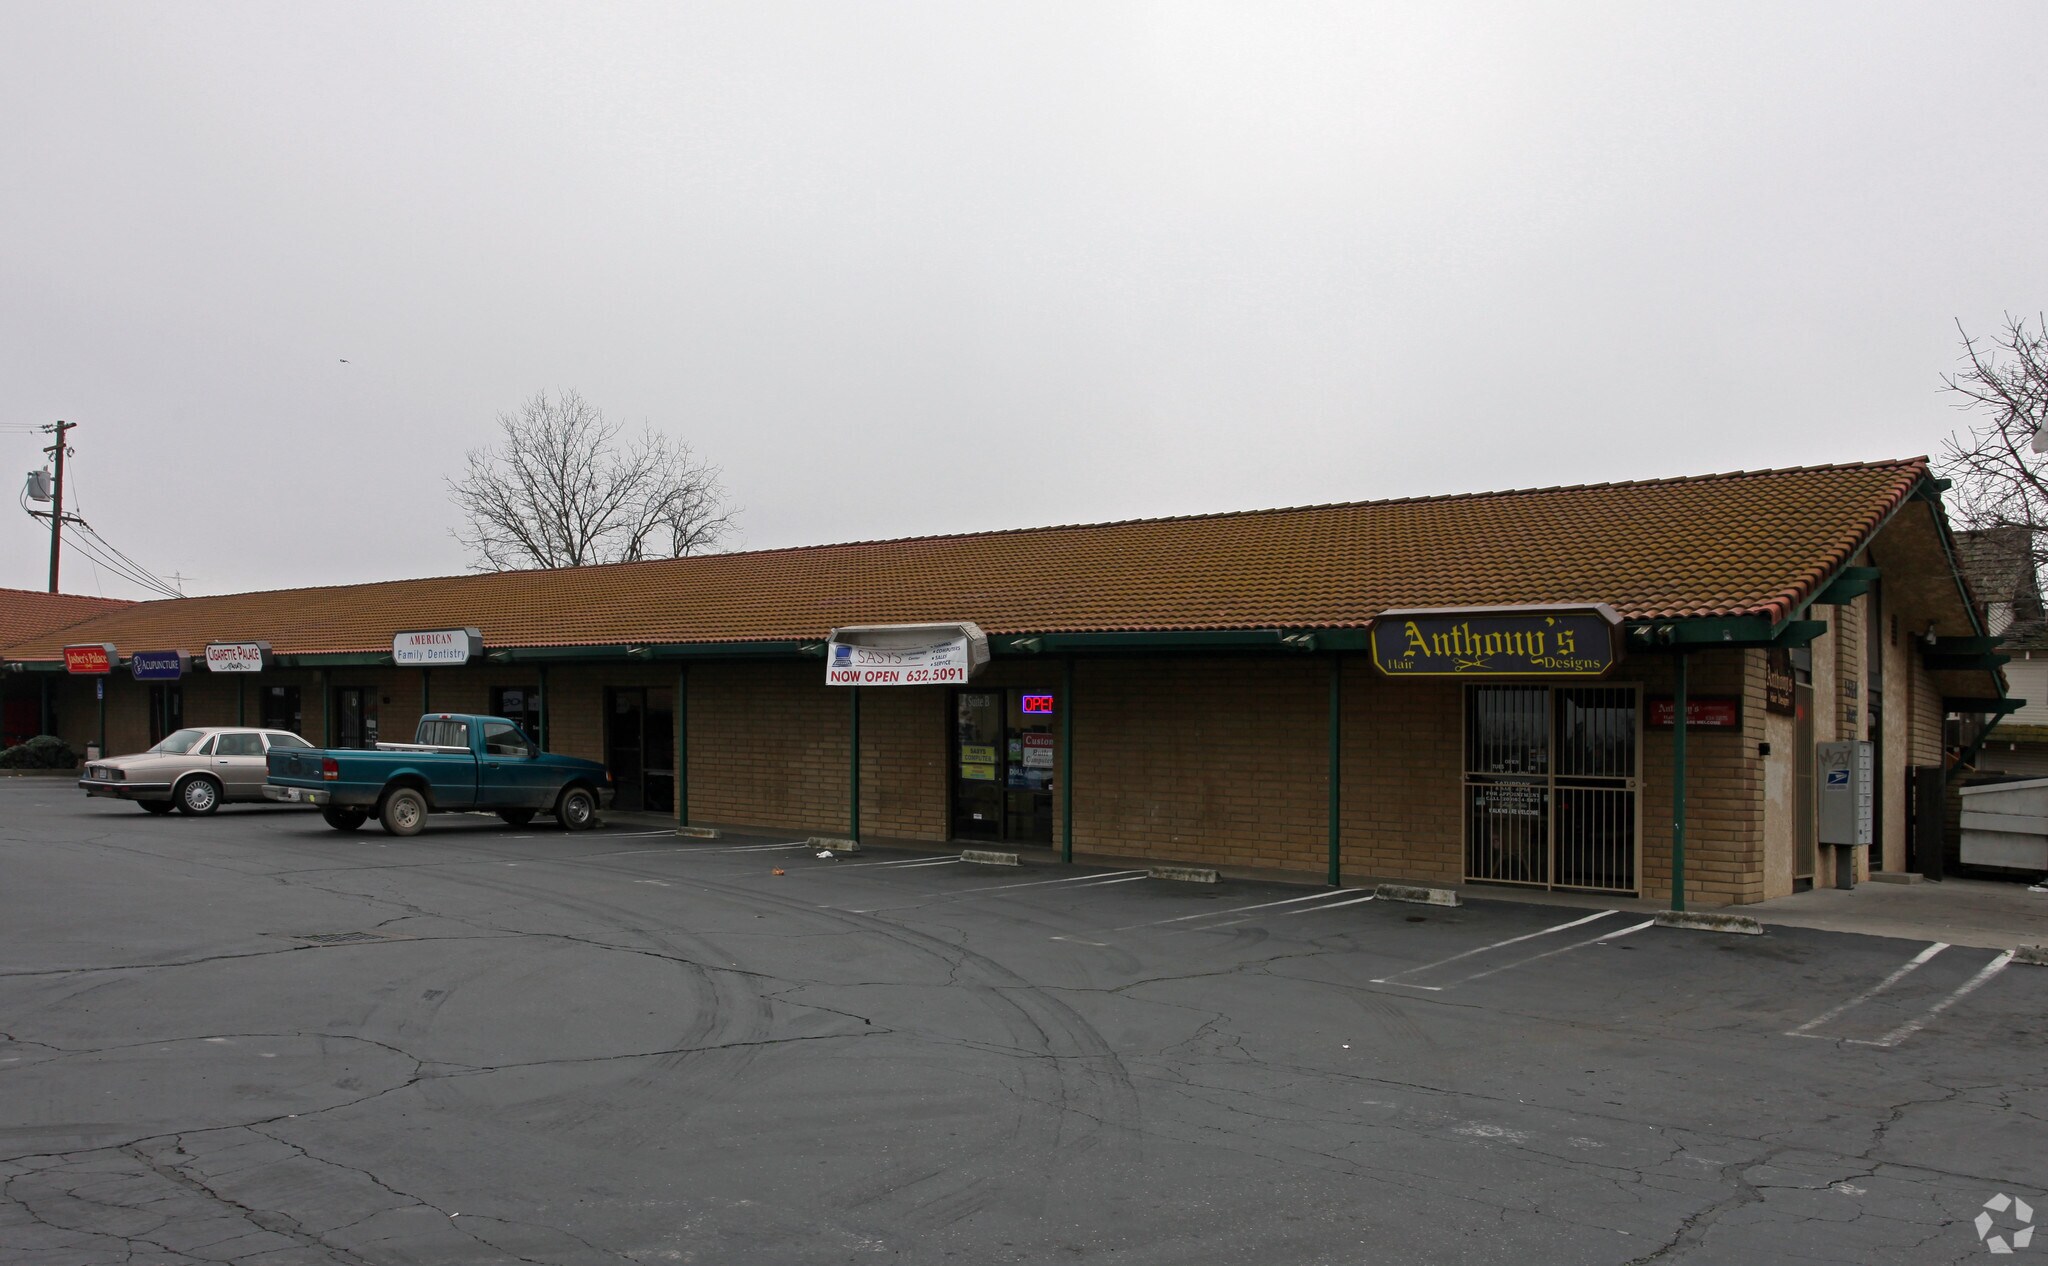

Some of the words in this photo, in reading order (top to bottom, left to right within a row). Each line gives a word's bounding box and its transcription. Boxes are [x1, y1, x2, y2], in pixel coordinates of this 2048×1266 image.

[409, 634, 452, 645] AMERICAN
[1403, 617, 1575, 665] Anthony's
[208, 646, 237, 660] CIGARETTE
[237, 646, 260, 660] PALACE
[398, 650, 423, 661] Family
[428, 649, 465, 660] Dentistry
[858, 650, 902, 664] SASYS
[142, 660, 179, 670] ACUPUNCTURE
[1388, 659, 1414, 669] Hair
[1545, 657, 1601, 671] Designs
[831, 671, 861, 682] NOW
[865, 670, 899, 682] OPEN
[906, 668, 963, 682] 632.5091
[968, 695, 984, 707] Suite
[984, 696, 990, 707] B
